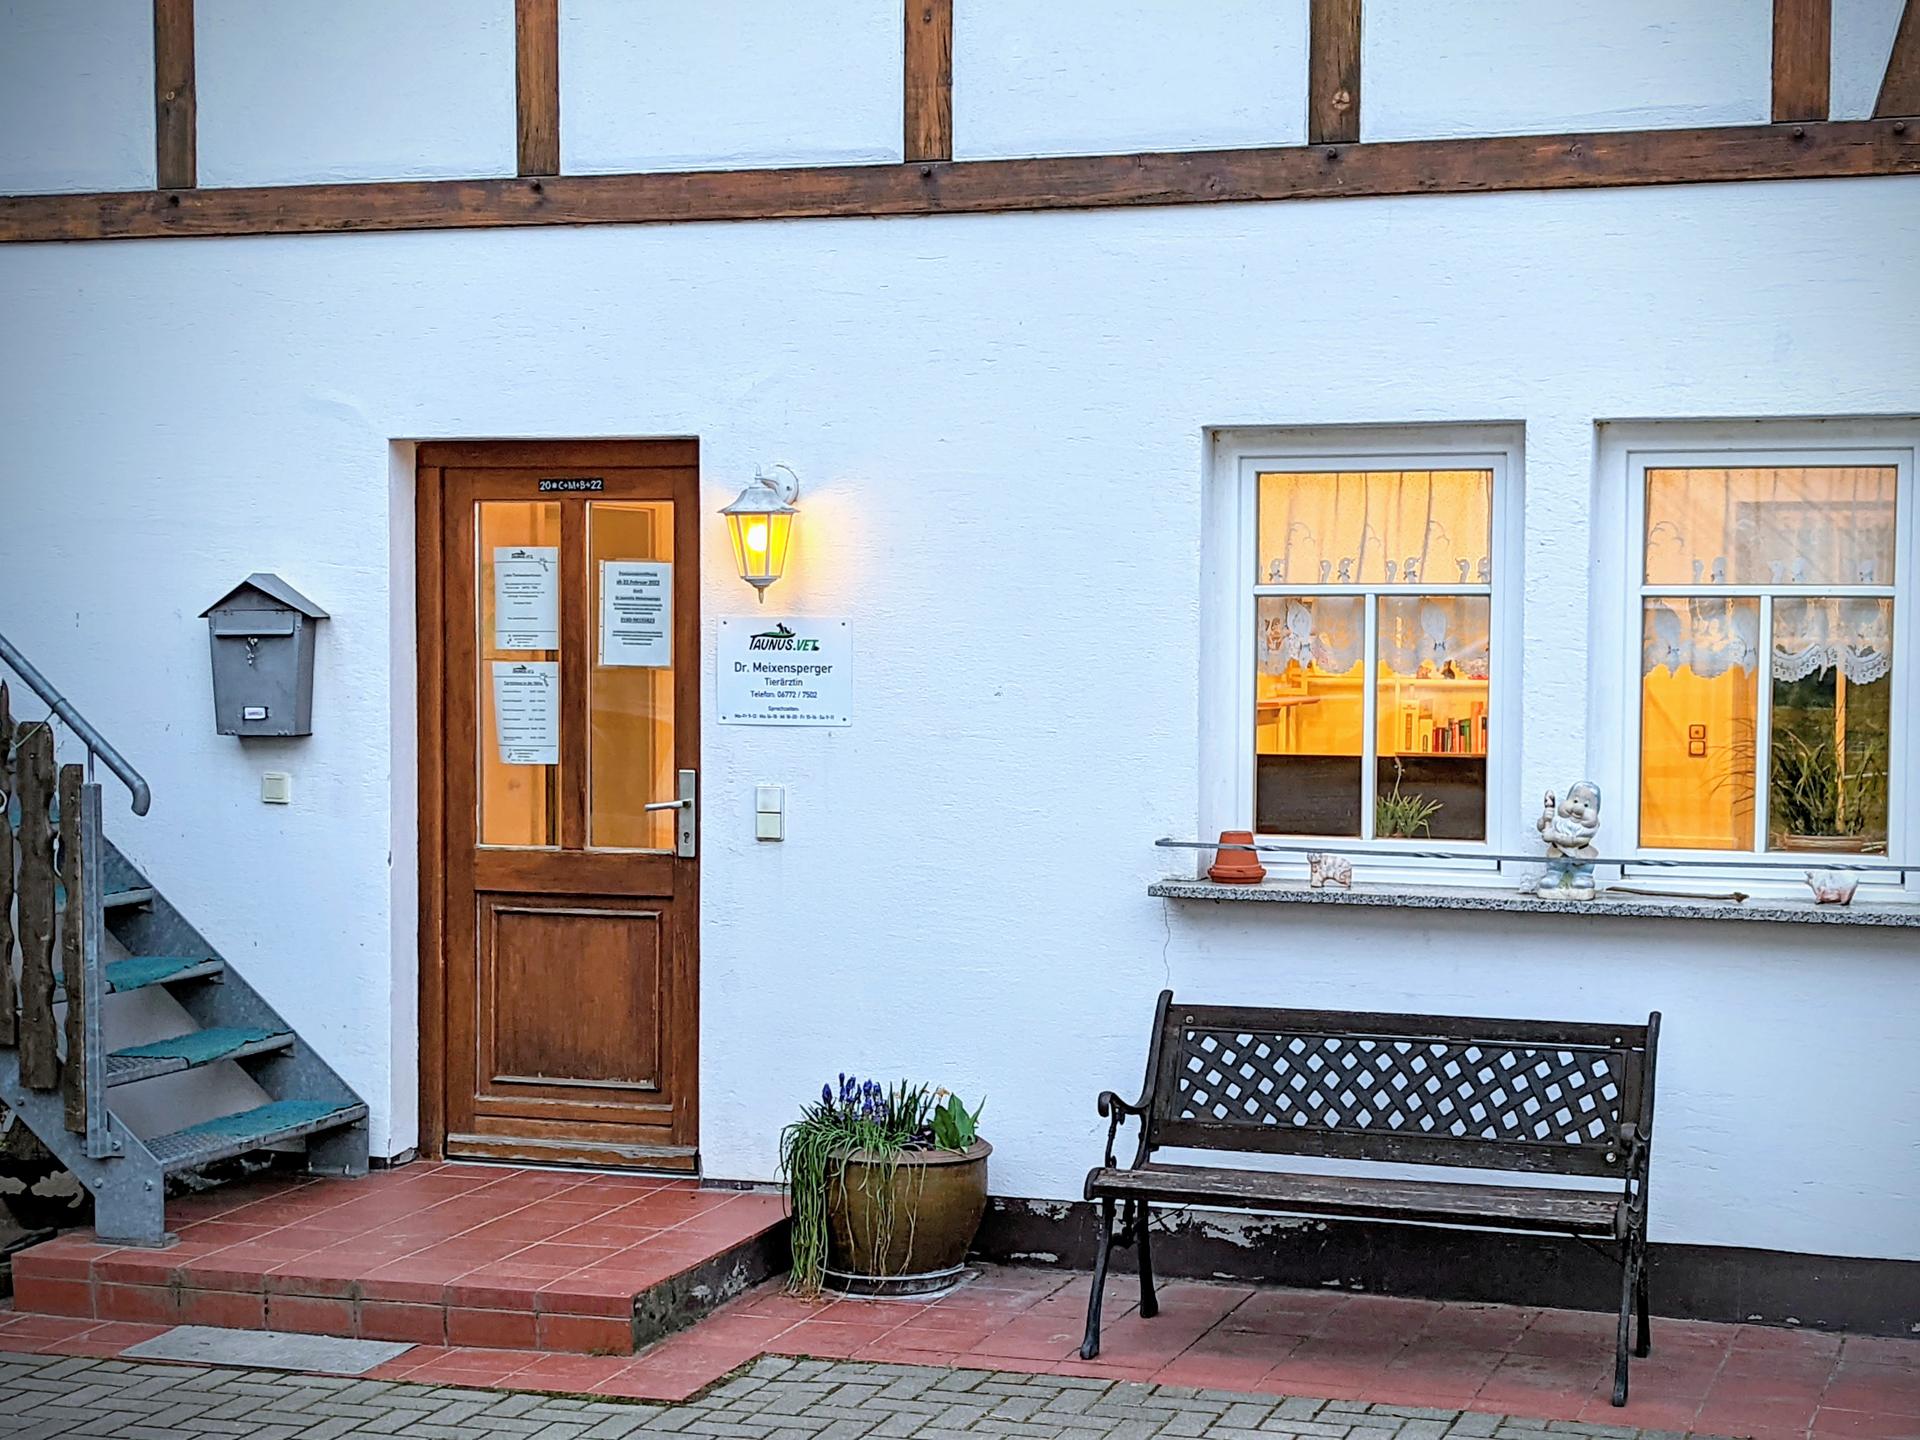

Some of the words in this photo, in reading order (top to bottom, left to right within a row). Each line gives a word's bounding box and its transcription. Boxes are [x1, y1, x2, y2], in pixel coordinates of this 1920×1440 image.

[734, 661, 750, 673] Dr.
[752, 662, 833, 676] Meixensperger
[764, 677, 803, 687] Tierärztin
[776, 690, 796, 698] 06772
